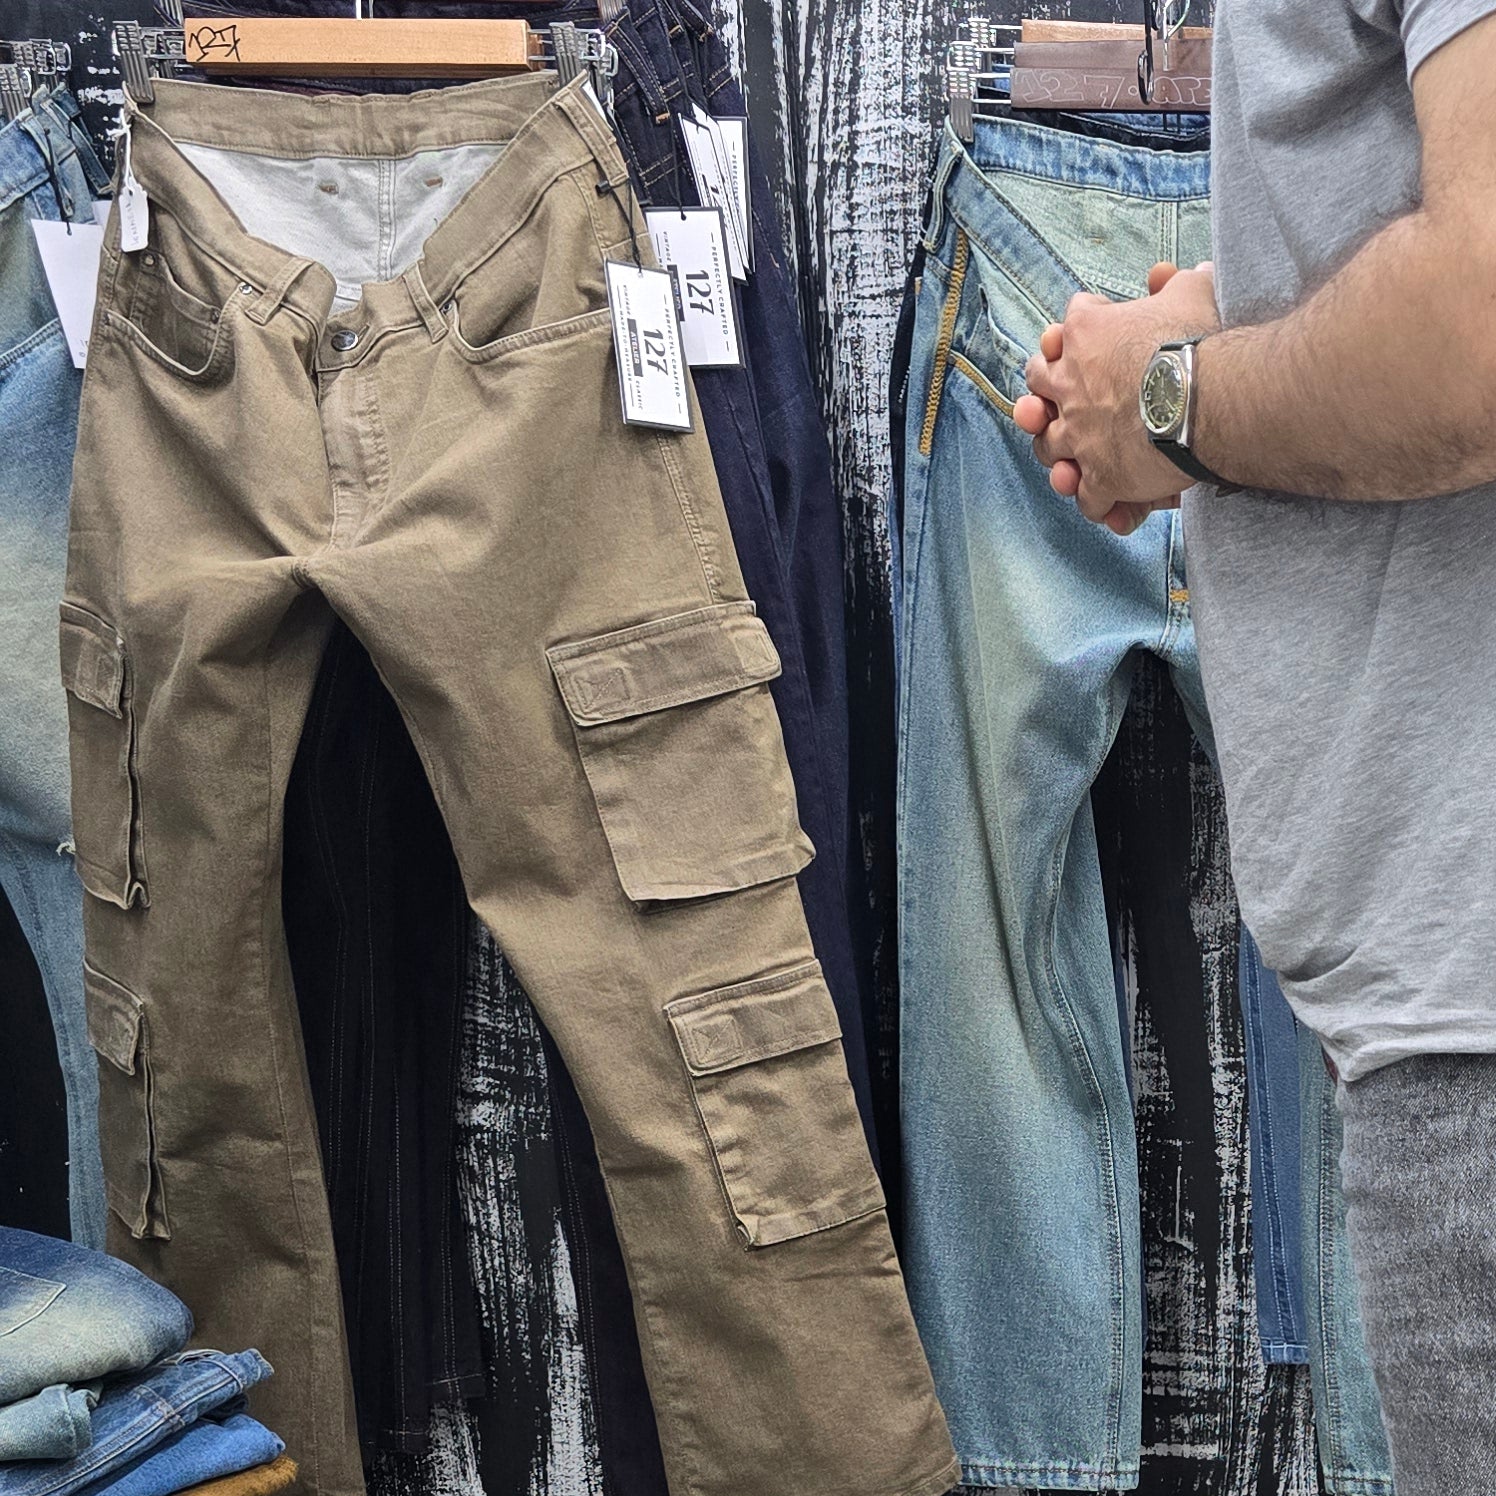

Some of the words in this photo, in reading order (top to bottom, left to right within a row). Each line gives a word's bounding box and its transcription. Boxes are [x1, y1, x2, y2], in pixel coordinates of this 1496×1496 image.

[686, 269, 715, 317] 127
[711, 246, 723, 294] PERFECTLY
[718, 296, 729, 336] CRAFTED
[630, 331, 640, 365] ATELIER
[643, 328, 669, 377] 127
[664, 308, 675, 354] PERFECTLY
[671, 355, 681, 398] CRAFTED
